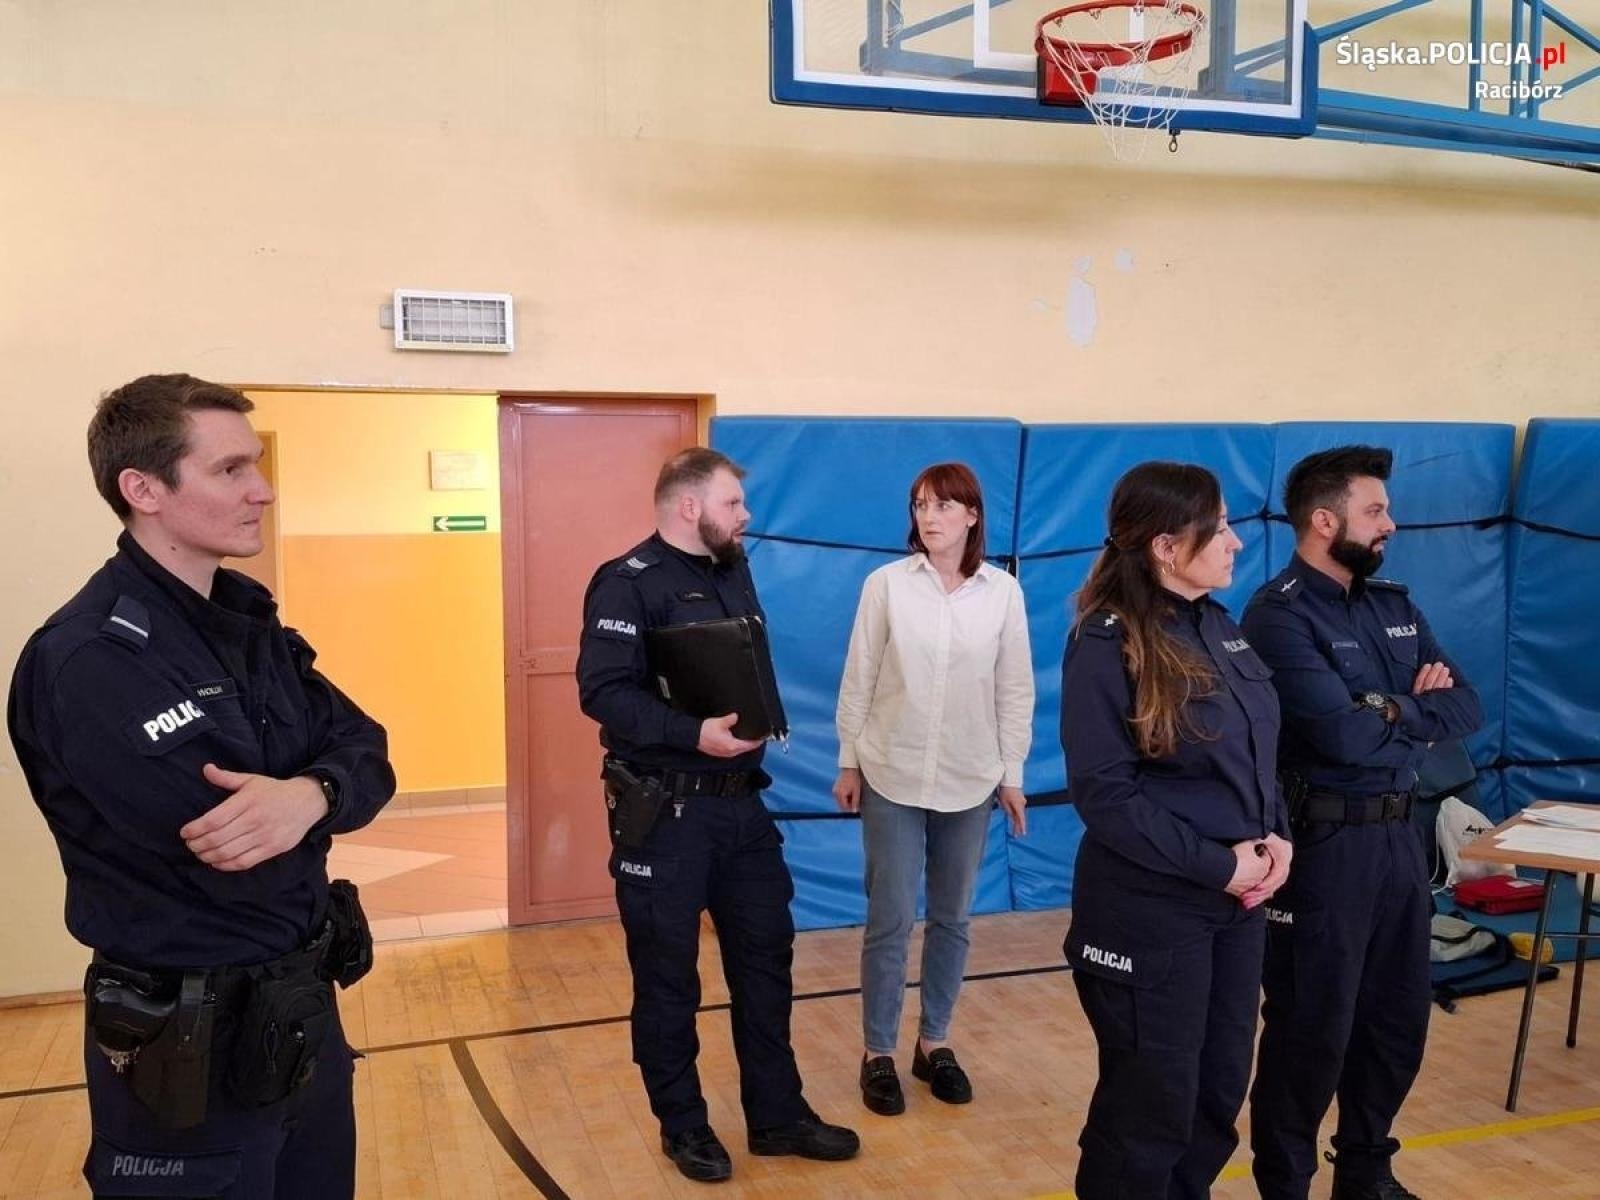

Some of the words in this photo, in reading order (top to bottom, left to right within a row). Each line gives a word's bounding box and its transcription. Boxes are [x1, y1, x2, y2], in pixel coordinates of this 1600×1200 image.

[597, 618, 637, 636] POLICJA
[143, 700, 205, 741] POLIC
[1083, 944, 1133, 973] POLICJA
[112, 1155, 184, 1176] POLICJA
